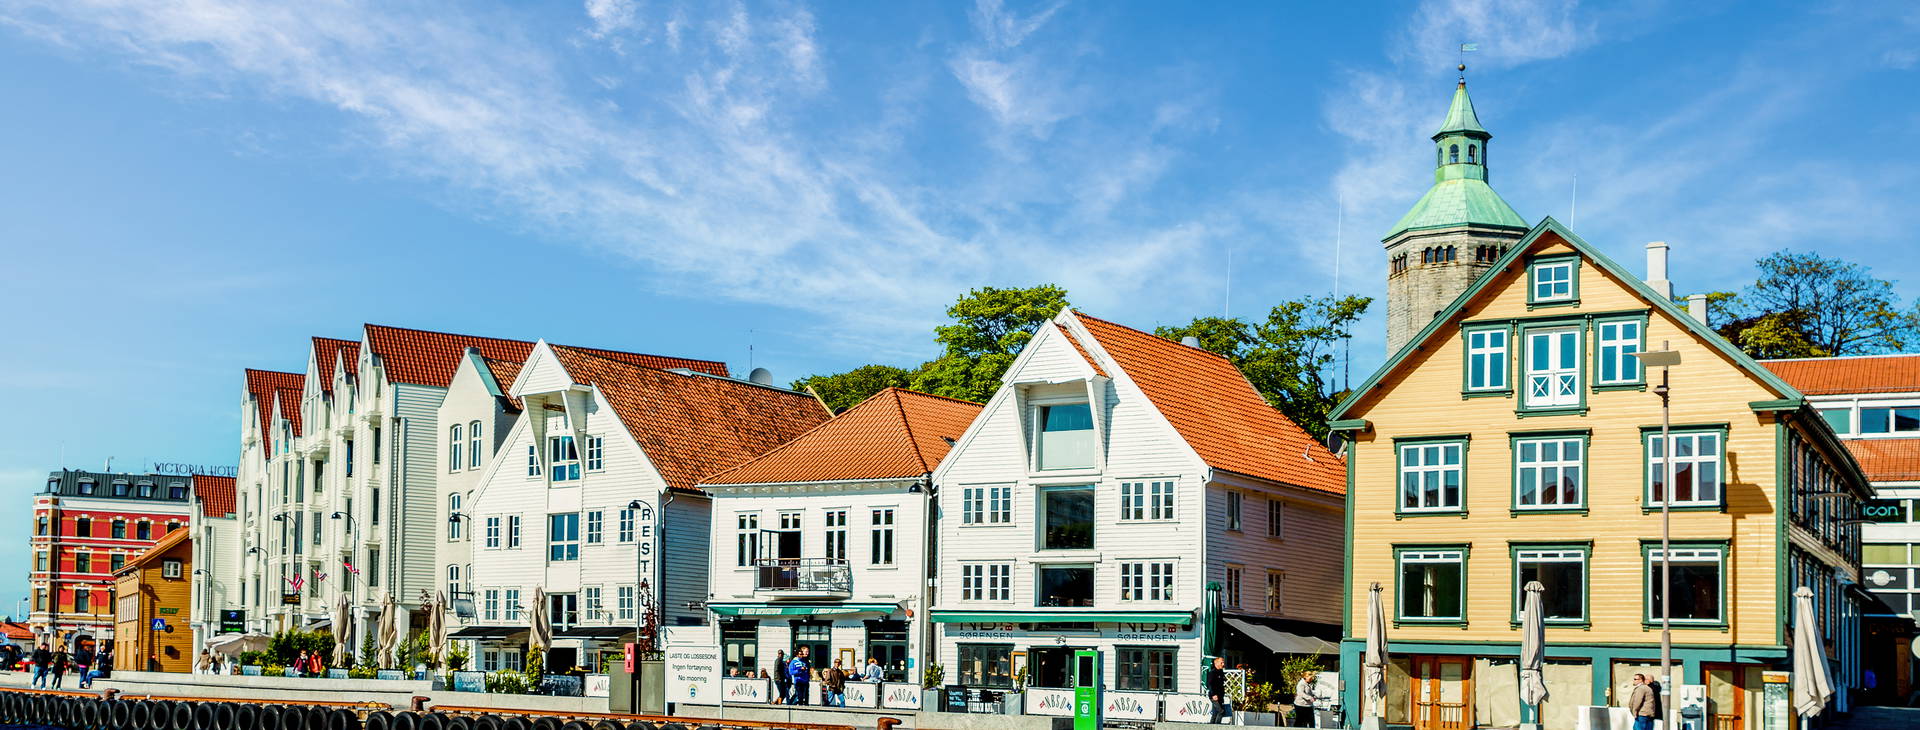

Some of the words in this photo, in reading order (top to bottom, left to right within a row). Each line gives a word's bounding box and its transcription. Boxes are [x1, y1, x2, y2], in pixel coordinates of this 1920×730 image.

[154, 462, 205, 475] VICTORIA
[1863, 505, 1899, 516] icon
[959, 632, 1013, 640] SØRENSEN
[672, 663, 686, 671] Ingen
